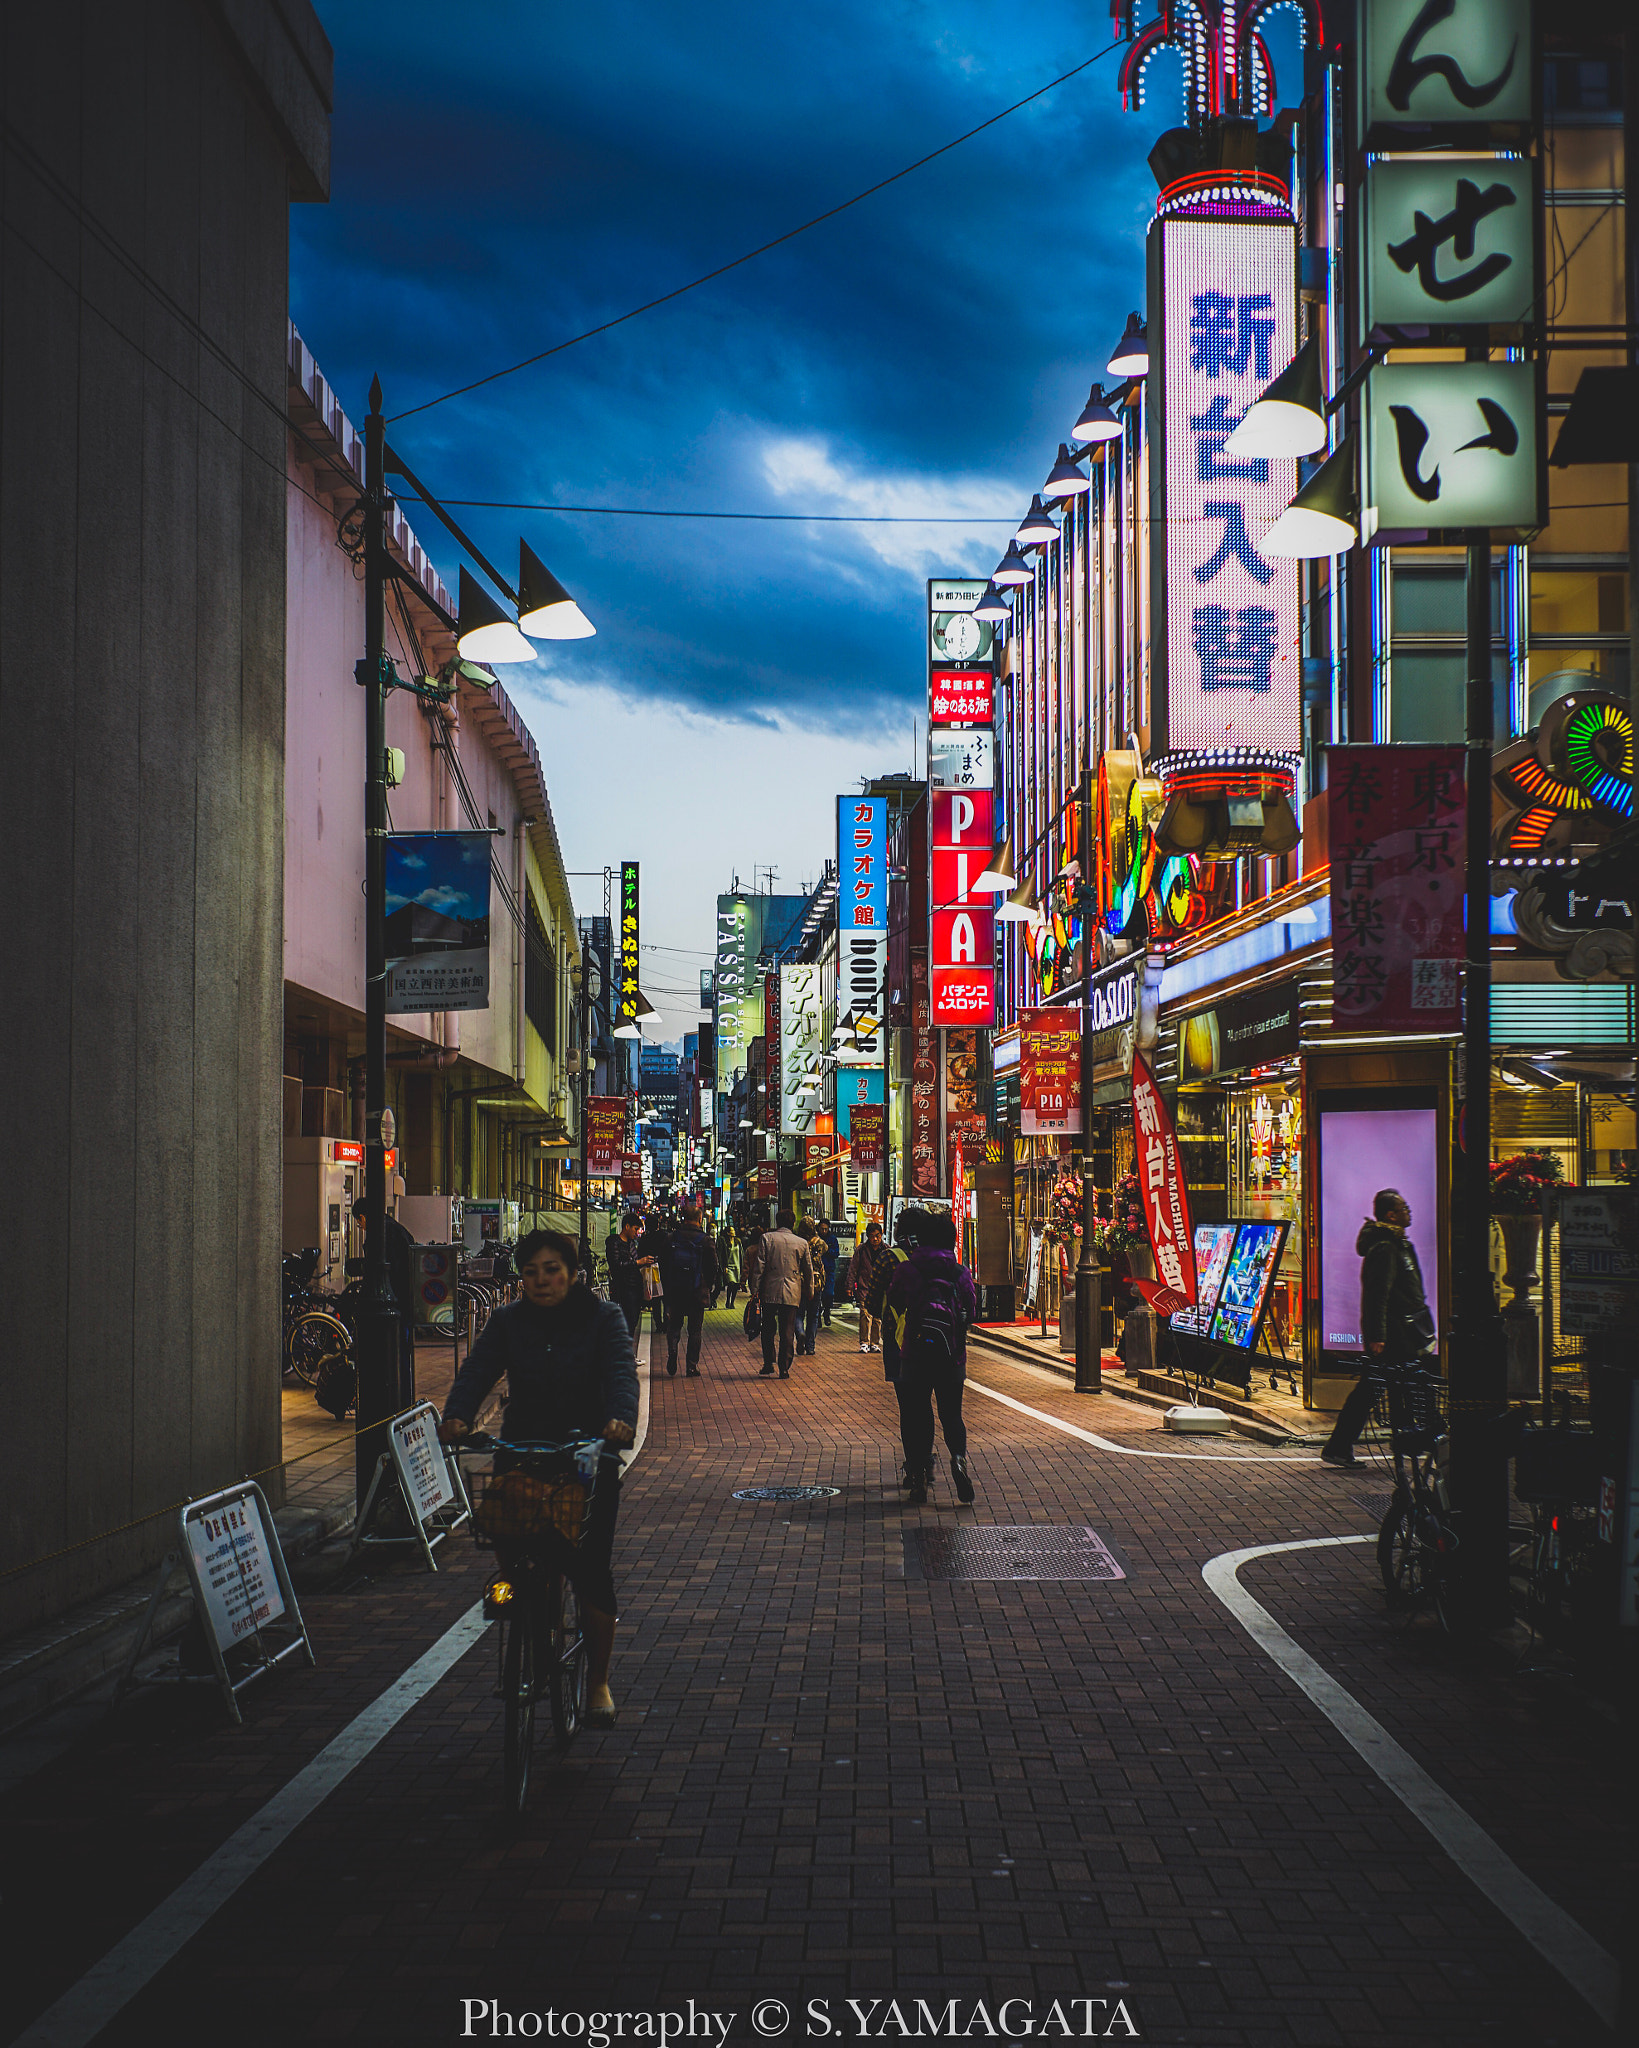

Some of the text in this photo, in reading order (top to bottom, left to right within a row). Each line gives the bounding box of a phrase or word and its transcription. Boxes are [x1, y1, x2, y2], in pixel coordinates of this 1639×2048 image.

[1190, 289, 1278, 692] 新台入替
[854, 803, 875, 926] カラオケ館
[951, 795, 975, 962] PIA
[624, 867, 637, 910] ホテル
[395, 975, 484, 991] 国立西洋美術館
[718, 912, 738, 1049] PASSAGE
[941, 984, 988, 997] パチンコ
[938, 997, 990, 1010] &スロット
[1021, 1030, 1081, 1043] リニューアル
[1040, 1094, 1063, 1108] PIA
[914, 1081, 935, 1160] 絵のある街
[595, 1150, 611, 1159] PIA
[861, 1150, 875, 1160] PIA
[1133, 1080, 1187, 1294] 新台入替
[1165, 1133, 1190, 1252] NEW MACHINE
[1329, 1332, 1357, 1344] FASHION
